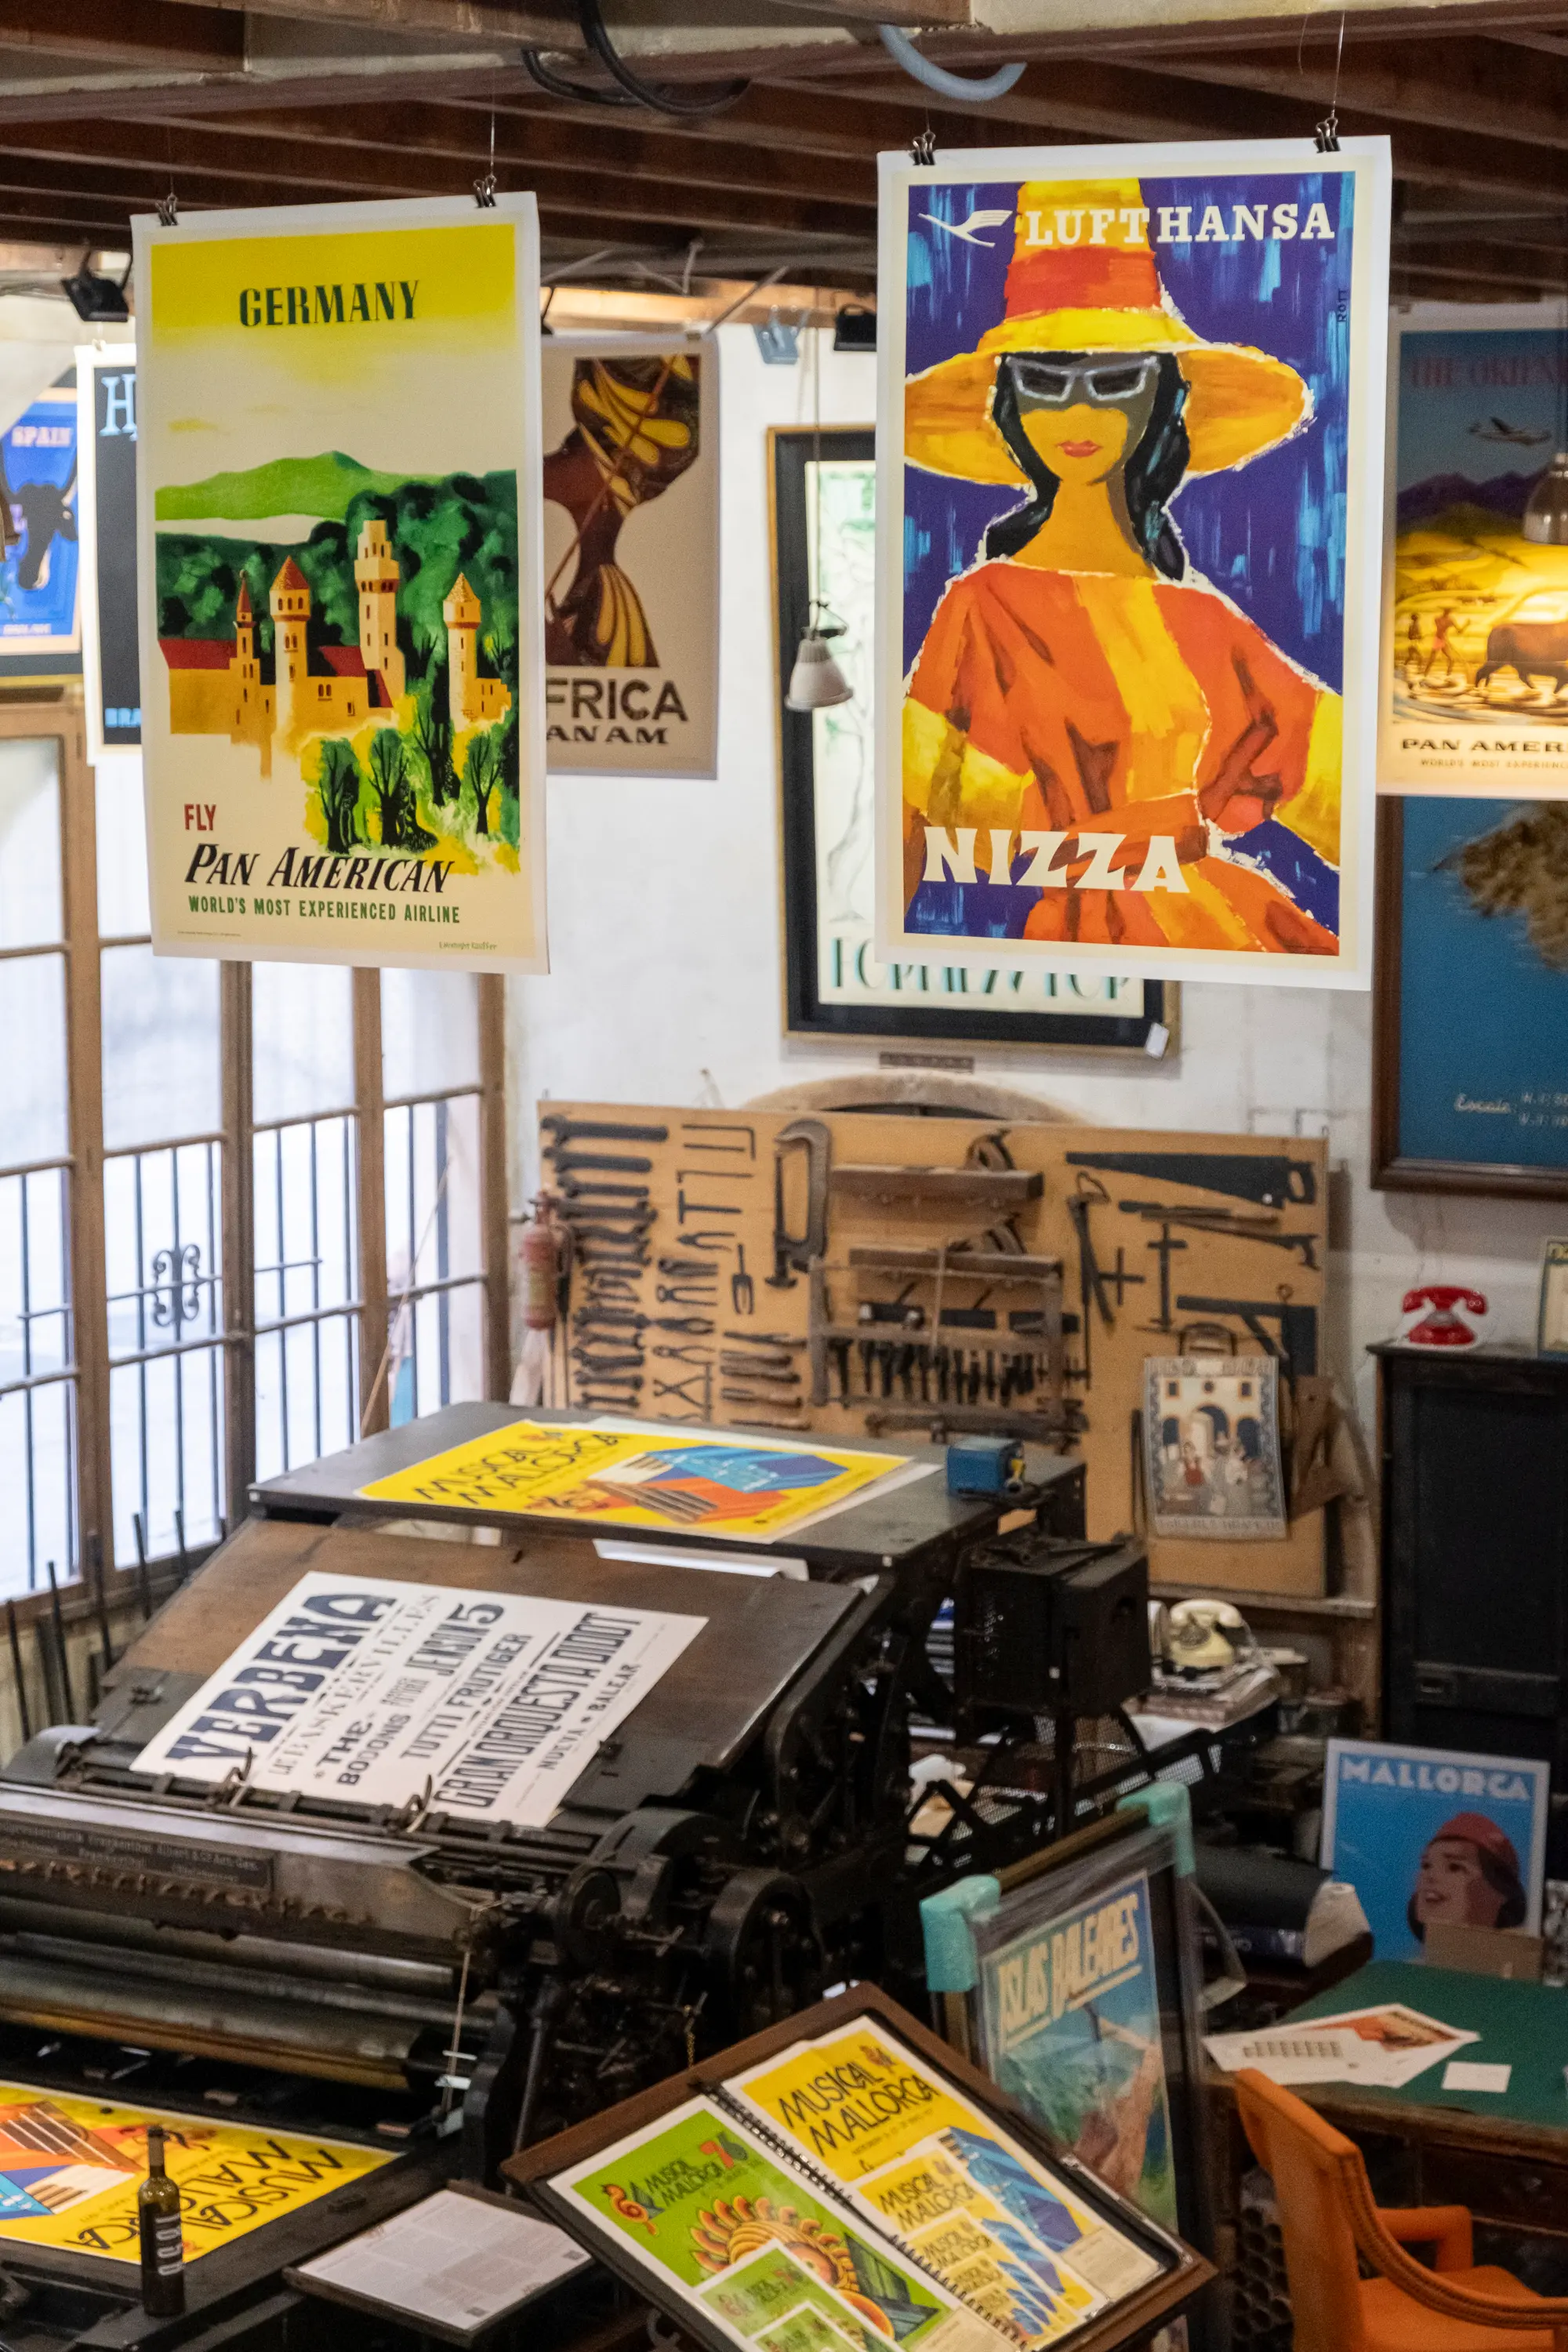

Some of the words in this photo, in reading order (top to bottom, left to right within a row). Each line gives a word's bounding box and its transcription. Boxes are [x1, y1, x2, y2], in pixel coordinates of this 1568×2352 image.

[1025, 202, 1335, 246] LUFTHANSA
[239, 279, 419, 327] GERMANY
[11, 426, 72, 448] SPAIN
[604, 726, 669, 745] AM
[1402, 737, 1461, 751] PAN
[1470, 739, 1568, 753] AMER
[183, 804, 216, 831] FLY
[184, 843, 260, 886] PAN
[267, 847, 455, 893] AMERICAN
[922, 826, 1191, 894] NIZZA
[188, 895, 247, 914] WORLD'S
[254, 898, 291, 916] MOST
[299, 900, 396, 920] EXPERIENCED
[404, 904, 460, 924] AIRLINE
[445, 1602, 505, 1624] 5
[549, 1612, 641, 1664] DIDOT
[404, 1623, 491, 1676] JENSON
[165, 1593, 397, 1759] VERBENA
[400, 1714, 464, 1759] TUTTI
[445, 1633, 534, 1708] FRUTIGER
[474, 1664, 601, 1757] ORQUESTA
[537, 1726, 586, 1770] NUEVA
[587, 1663, 641, 1711] BALEAR
[316, 1720, 374, 1766] THE
[433, 1755, 524, 1809] GRAN
[1341, 1755, 1530, 1802] MALLORCA
[779, 2061, 885, 2129] MUSICAL
[810, 2074, 940, 2156] MALLORCA
